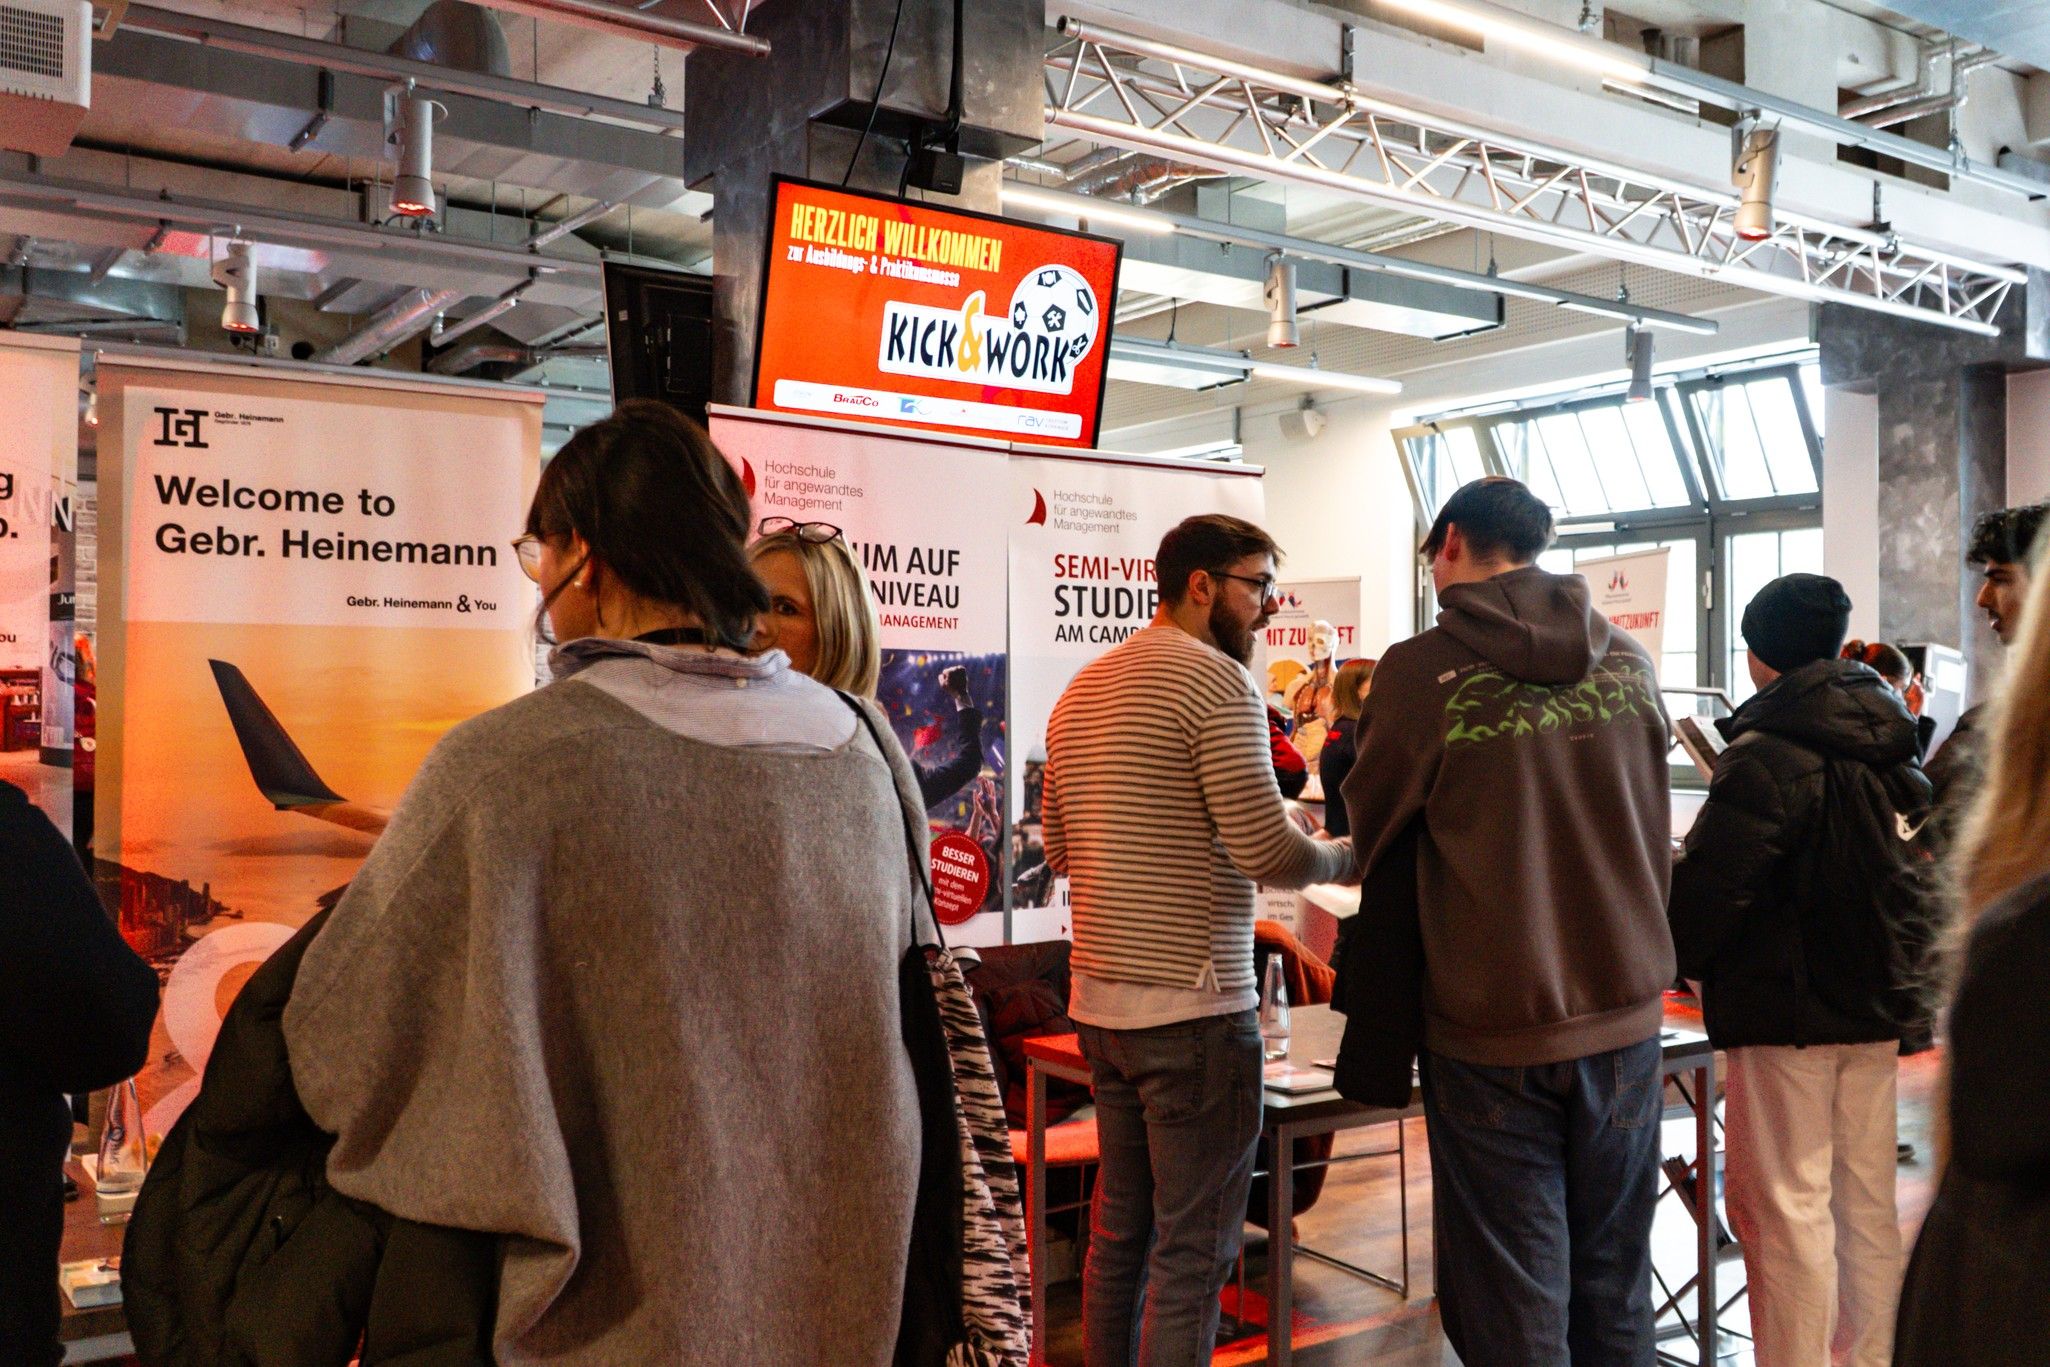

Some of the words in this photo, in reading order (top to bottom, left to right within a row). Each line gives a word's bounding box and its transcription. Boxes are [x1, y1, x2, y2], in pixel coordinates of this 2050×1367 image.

[790, 203, 879, 252] HERZLICH
[884, 219, 1003, 273] WILLKOMMEN
[787, 245, 804, 262] zur
[805, 244, 868, 274] Ausbildungs-
[869, 255, 878, 274] &
[239, 413, 284, 423] Heinemann
[764, 460, 836, 479] Hochschule
[154, 475, 344, 514] Welcome
[358, 489, 396, 517] to
[764, 476, 780, 489] für
[784, 480, 863, 498] angewandtes
[1053, 490, 1113, 505] Hochschule
[764, 492, 842, 511] Management
[1053, 505, 1066, 516] für
[1070, 507, 1137, 521] angewandtes
[1053, 519, 1119, 534] Management
[155, 523, 265, 557] Gebr.
[282, 529, 497, 566] Heinemann
[906, 546, 960, 577] AUF
[1054, 554, 1157, 582] SEMI-VIR
[346, 596, 380, 607] Gebr.
[384, 597, 452, 609] Heinemann
[457, 594, 471, 613] &
[474, 600, 497, 610] You
[871, 580, 959, 609] NIVEAU
[1054, 585, 1158, 619] STUDIE
[880, 614, 959, 630] ANAGEMENT
[1055, 624, 1084, 643] AM
[942, 846, 975, 866] BESSER
[931, 858, 980, 883] STUDIEREN
